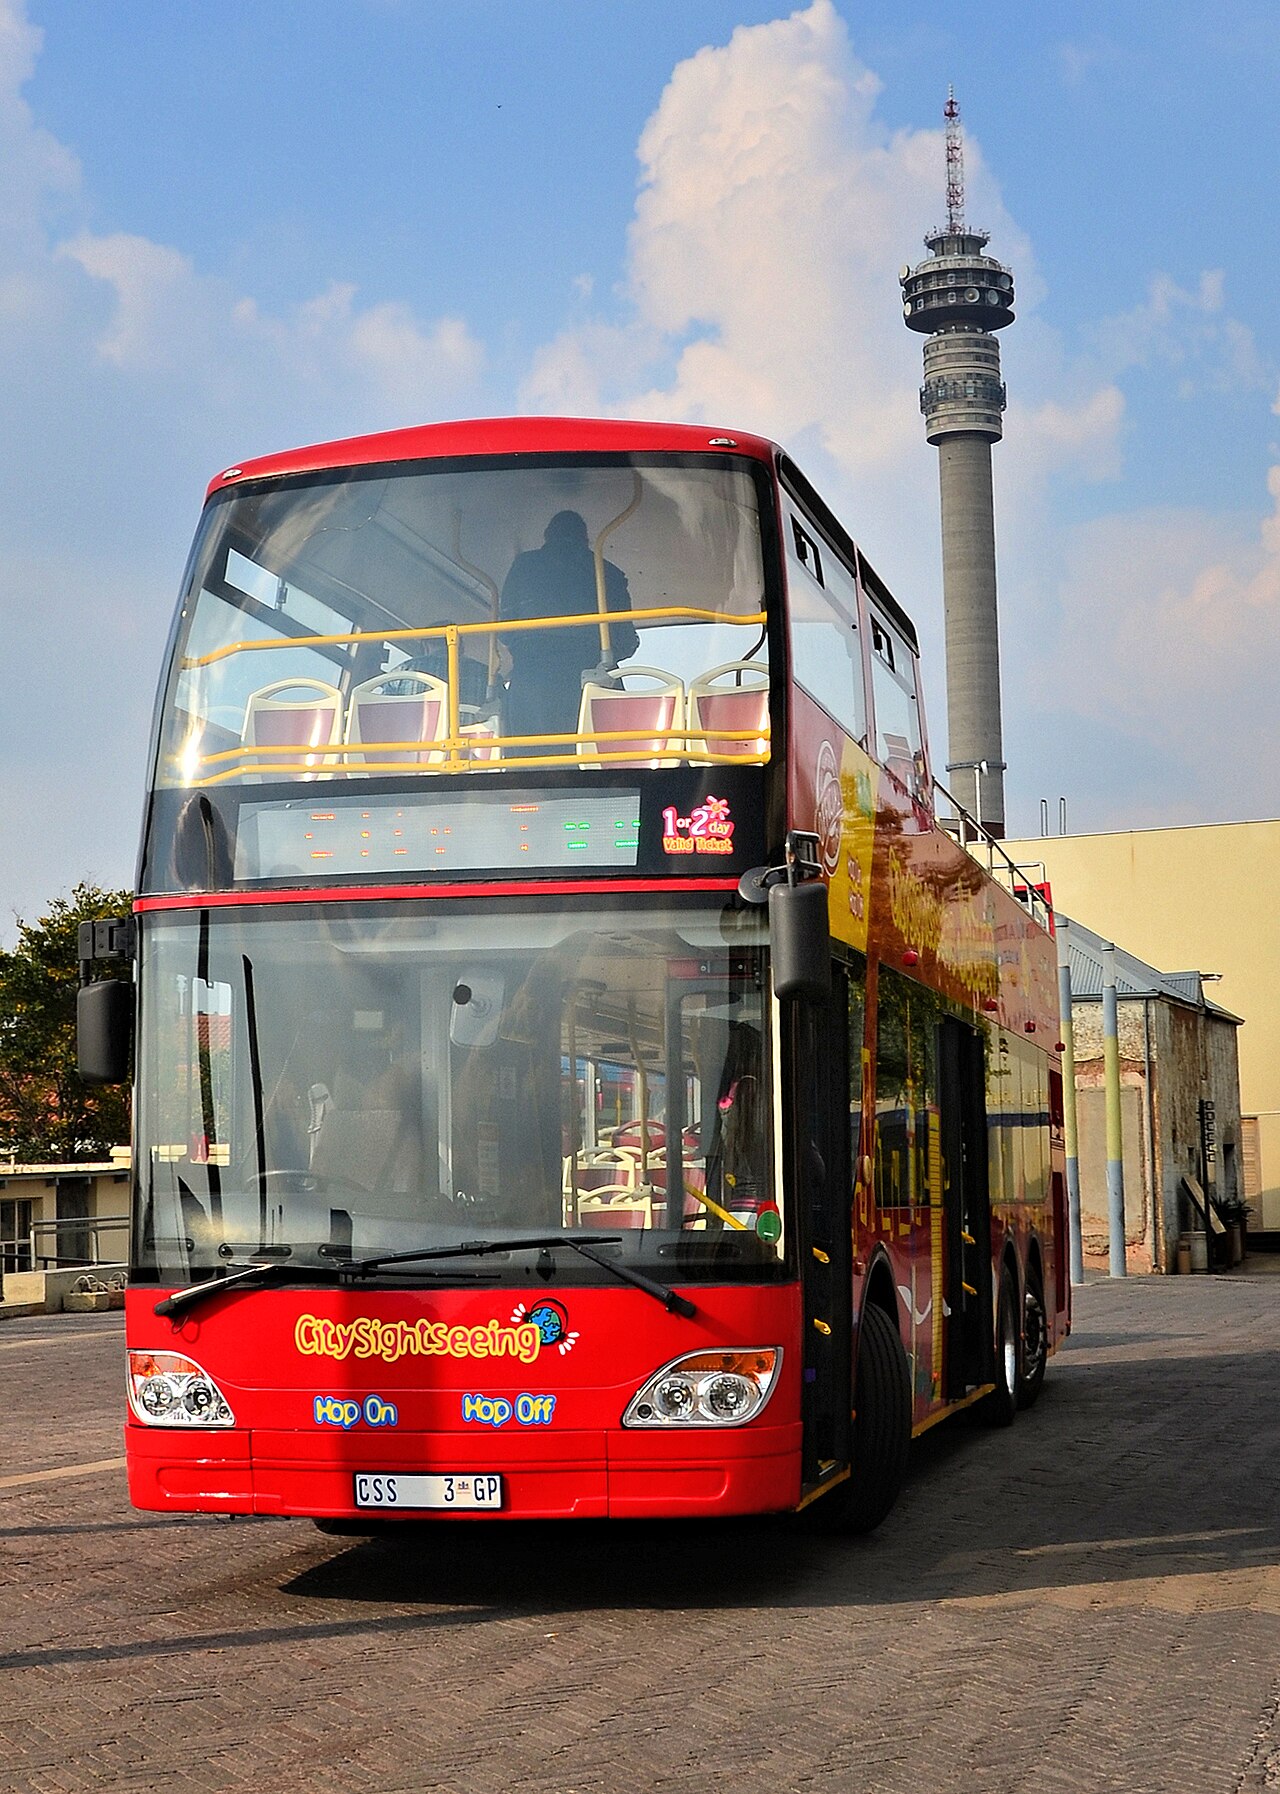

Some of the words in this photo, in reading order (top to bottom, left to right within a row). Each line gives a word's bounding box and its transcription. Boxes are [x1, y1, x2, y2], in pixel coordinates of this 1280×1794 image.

[663, 808, 676, 836] 1
[676, 818, 692, 828] or
[690, 809, 709, 836] 2
[708, 821, 731, 835] day
[663, 837, 695, 852] Valid
[695, 837, 733, 852] Ticket
[315, 1396, 360, 1428] Hop
[364, 1395, 398, 1425] On
[464, 1394, 511, 1427] Hop
[515, 1393, 556, 1424] Off
[358, 1478, 397, 1502] CSS
[444, 1478, 454, 1502] 3
[473, 1477, 498, 1501] GP
